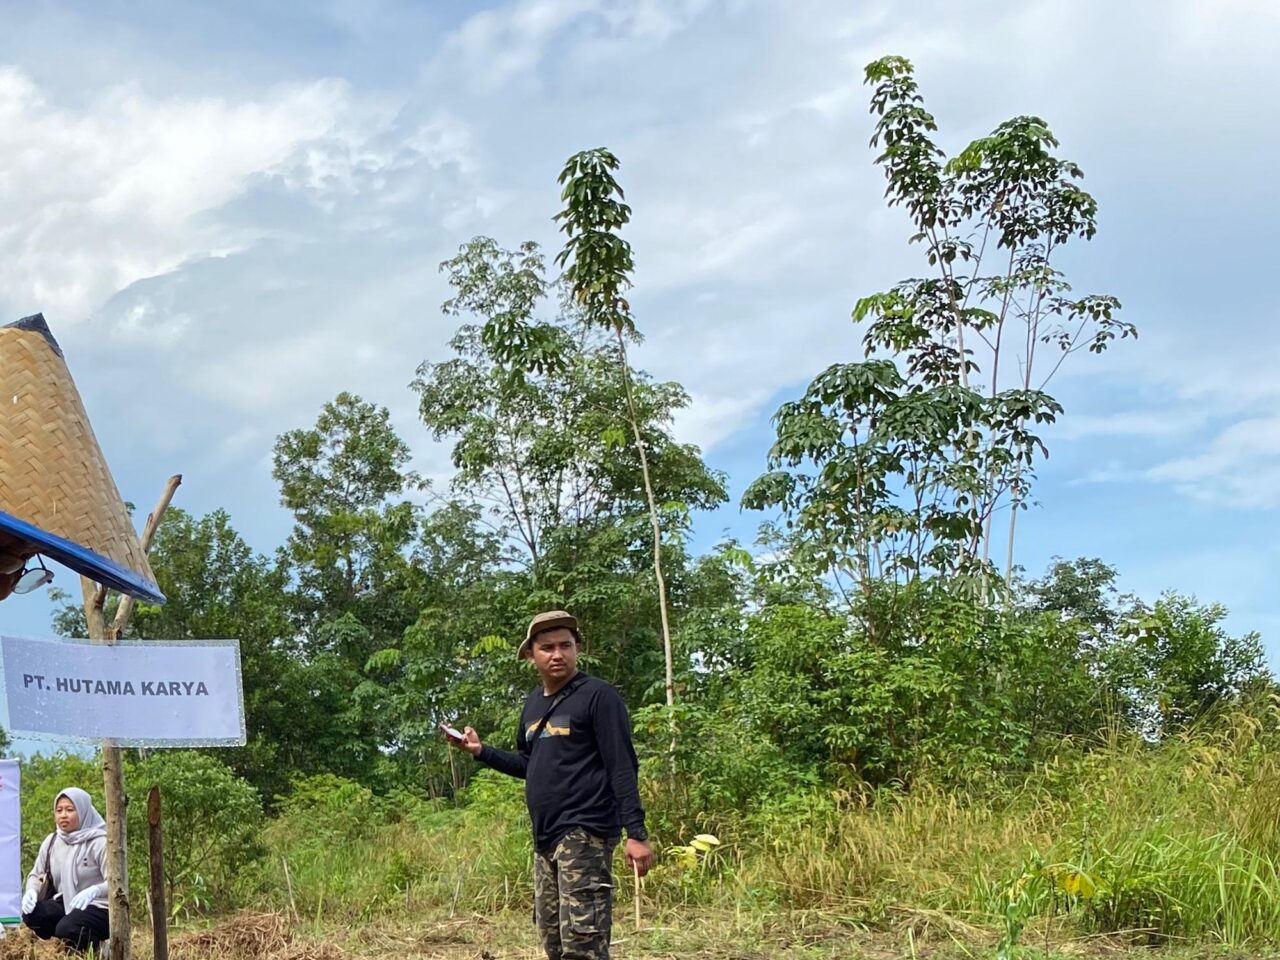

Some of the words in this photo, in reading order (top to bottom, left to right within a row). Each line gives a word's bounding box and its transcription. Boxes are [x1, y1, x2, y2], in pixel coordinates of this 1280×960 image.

[23, 673, 51, 691] PT.
[56, 677, 136, 696] HUTAMA
[141, 681, 209, 696] KARYA
